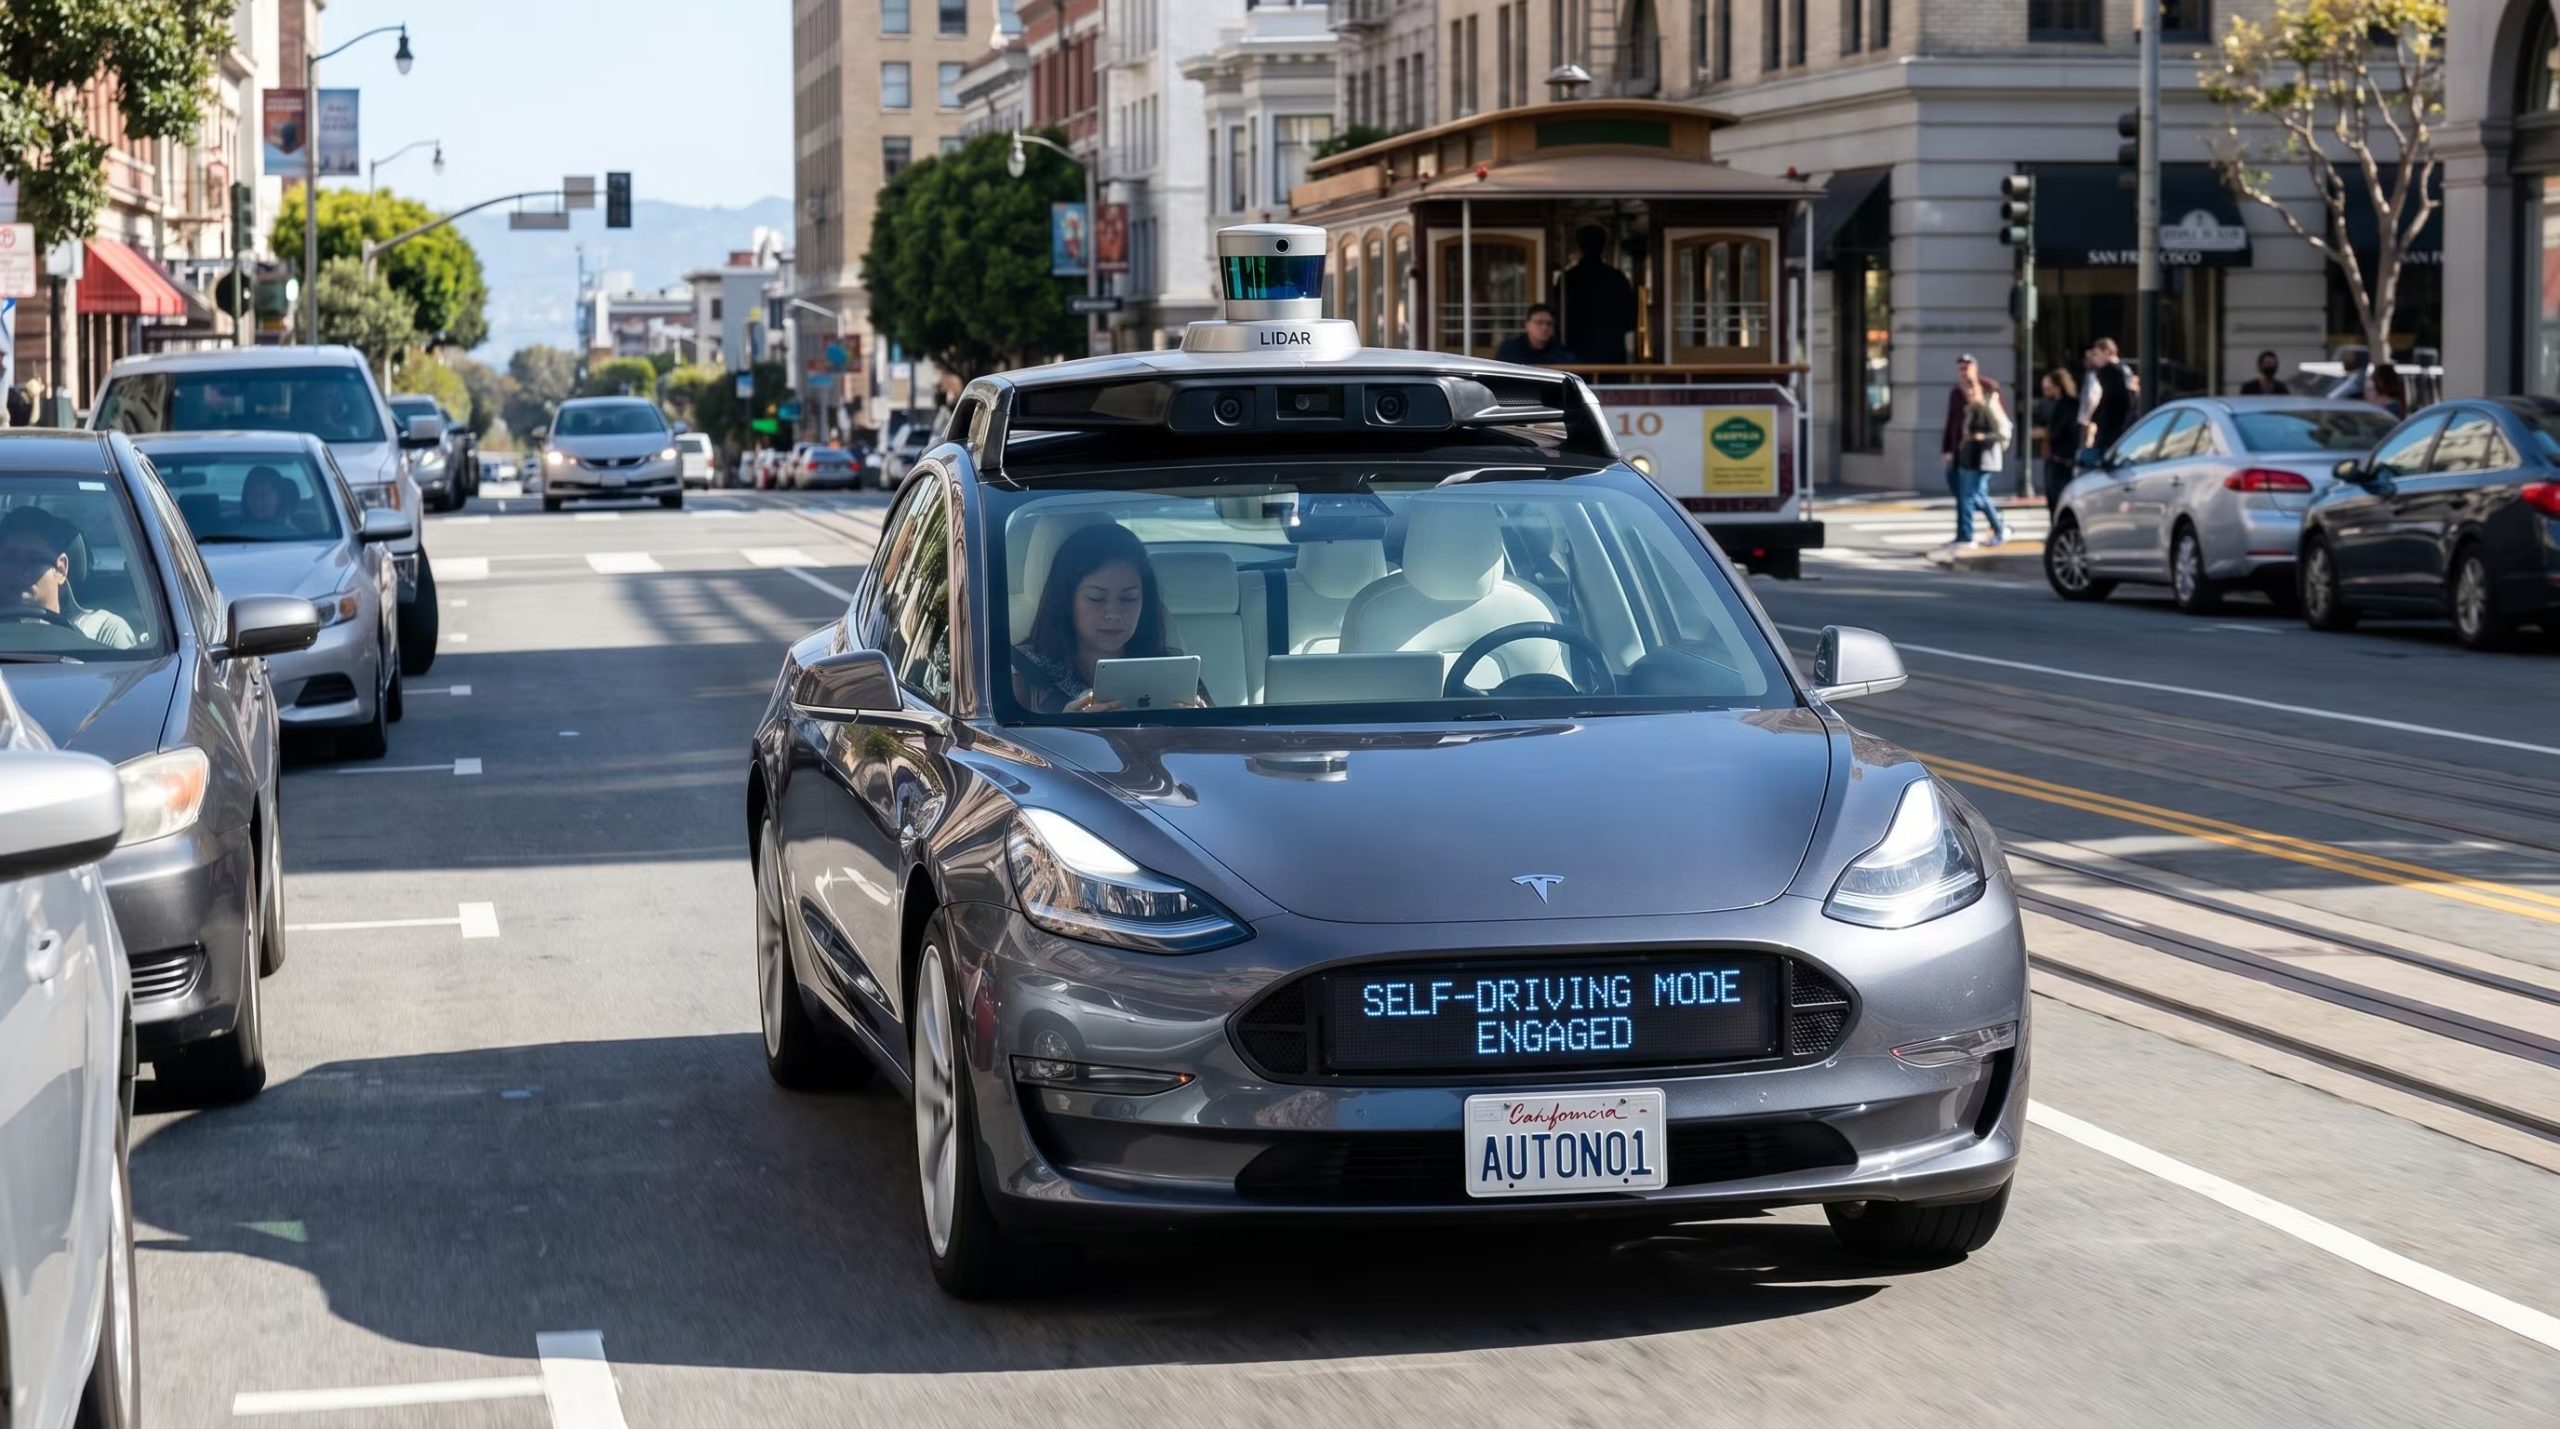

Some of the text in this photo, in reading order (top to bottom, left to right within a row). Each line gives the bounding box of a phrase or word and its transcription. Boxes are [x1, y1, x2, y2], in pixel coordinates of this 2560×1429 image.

[2088, 251, 2202, 264] SAN FRCISCO
[1260, 331, 1311, 345] LIDAR
[1617, 413, 1662, 436] 10
[1363, 969, 1741, 1017] SELF-DRIVING MODE
[1477, 1016, 1632, 1054] ENGAGED
